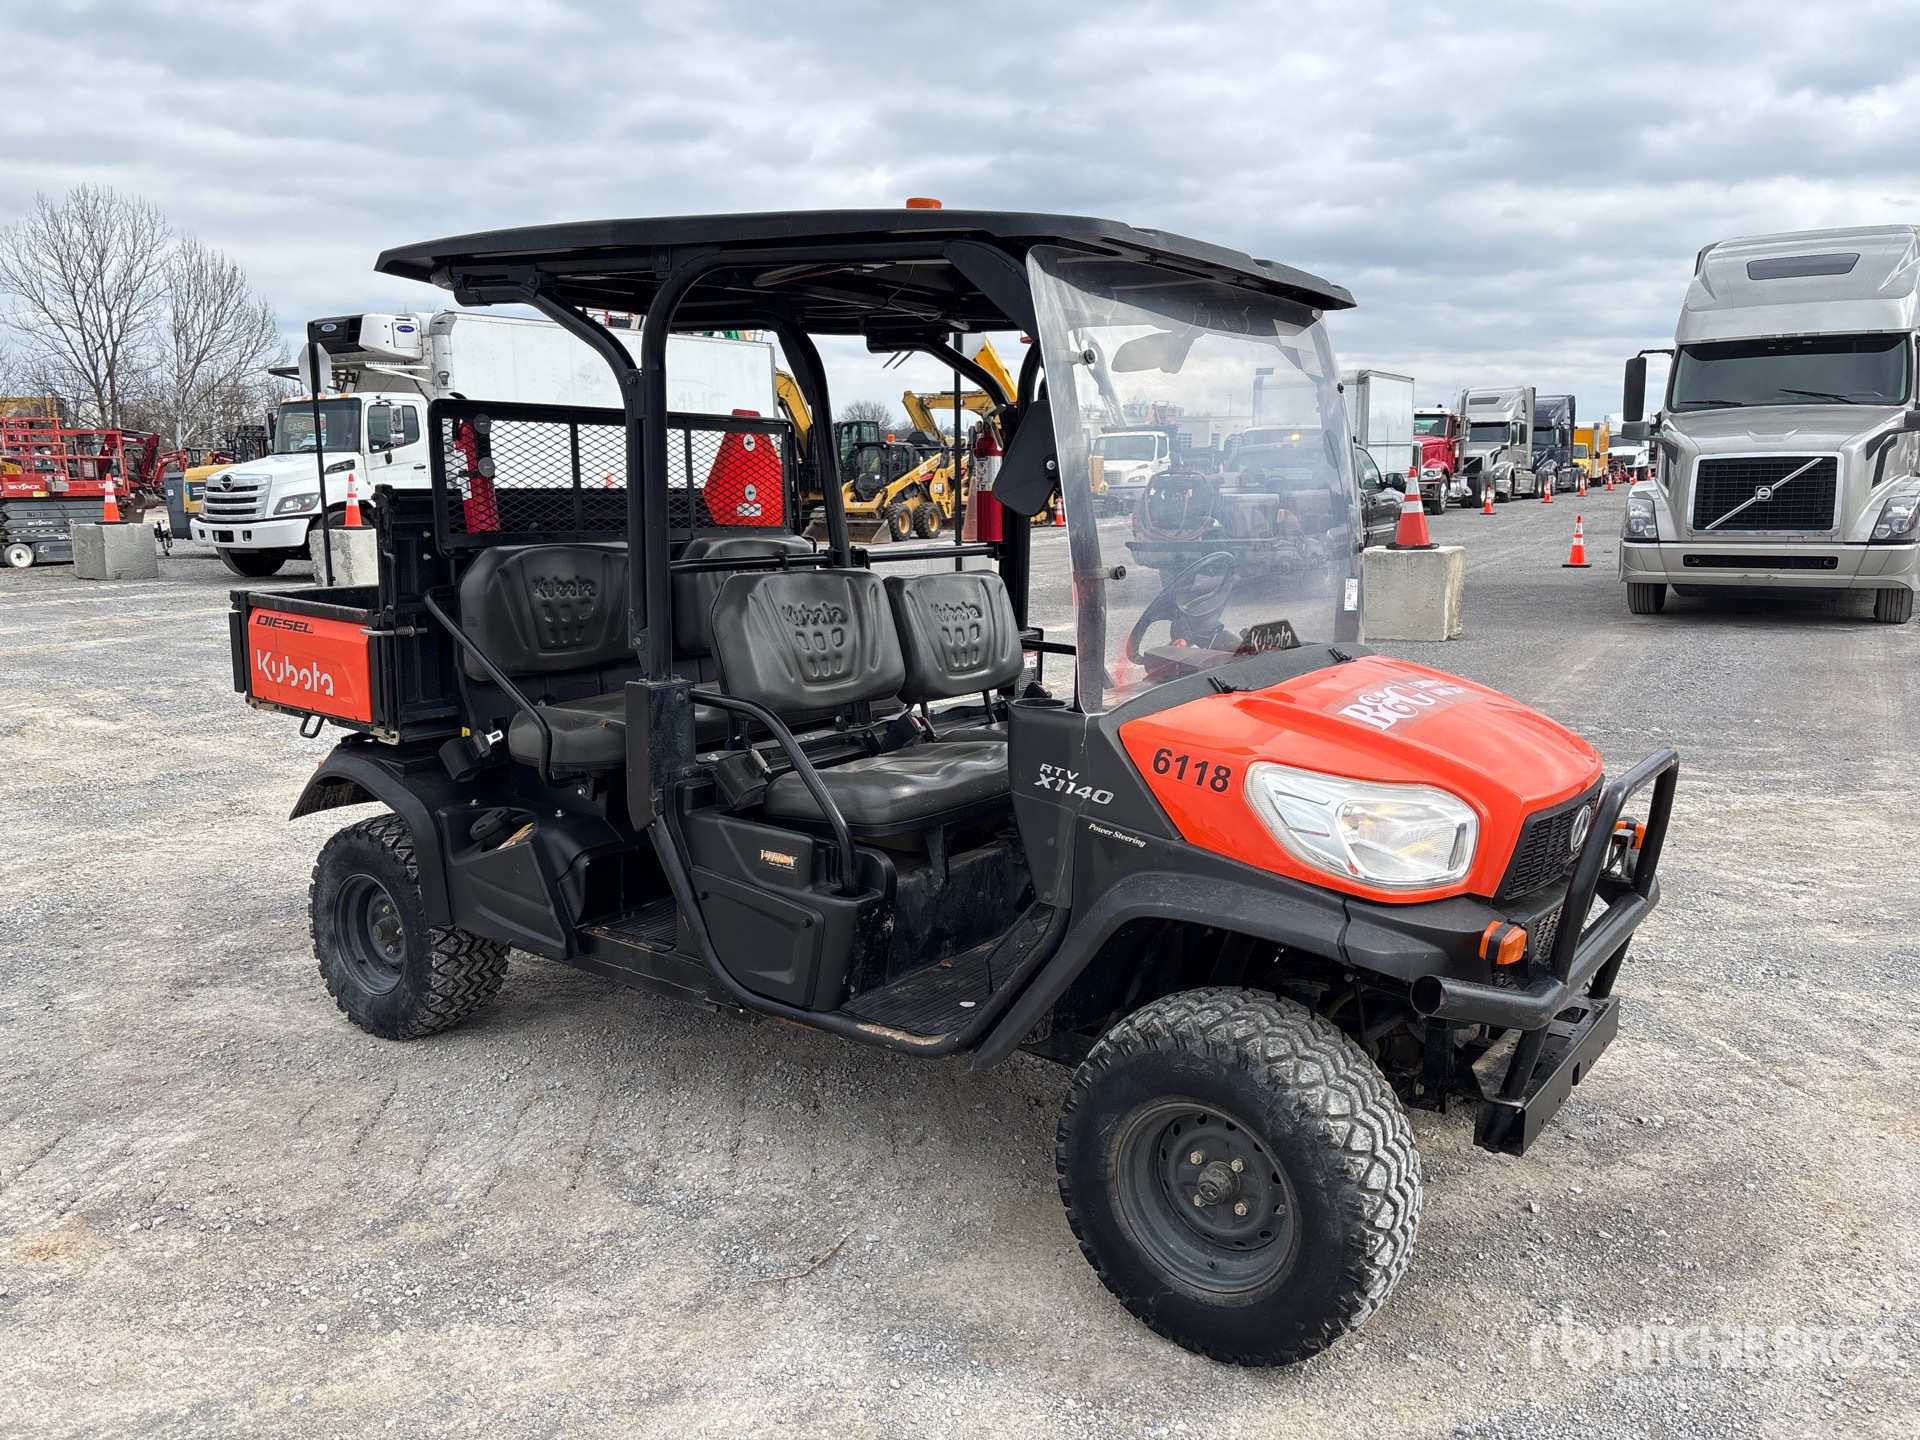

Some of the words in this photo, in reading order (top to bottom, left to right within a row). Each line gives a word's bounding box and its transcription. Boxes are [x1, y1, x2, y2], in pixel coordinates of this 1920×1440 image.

[288, 421, 307, 431] CASE
[8, 483, 41, 491] SKYJACK
[532, 575, 597, 600] Kubota
[256, 614, 314, 634] DIESEL
[782, 602, 848, 627] Kubota
[931, 601, 983, 622] Kubota
[1251, 625, 1292, 652] Kubota
[256, 649, 334, 697] Kubota
[1039, 763, 1080, 780] RTV
[1153, 748, 1232, 793] 6118
[1034, 774, 1114, 805] X1140
[1088, 823, 1113, 837] Power
[1113, 830, 1147, 848] Steering
